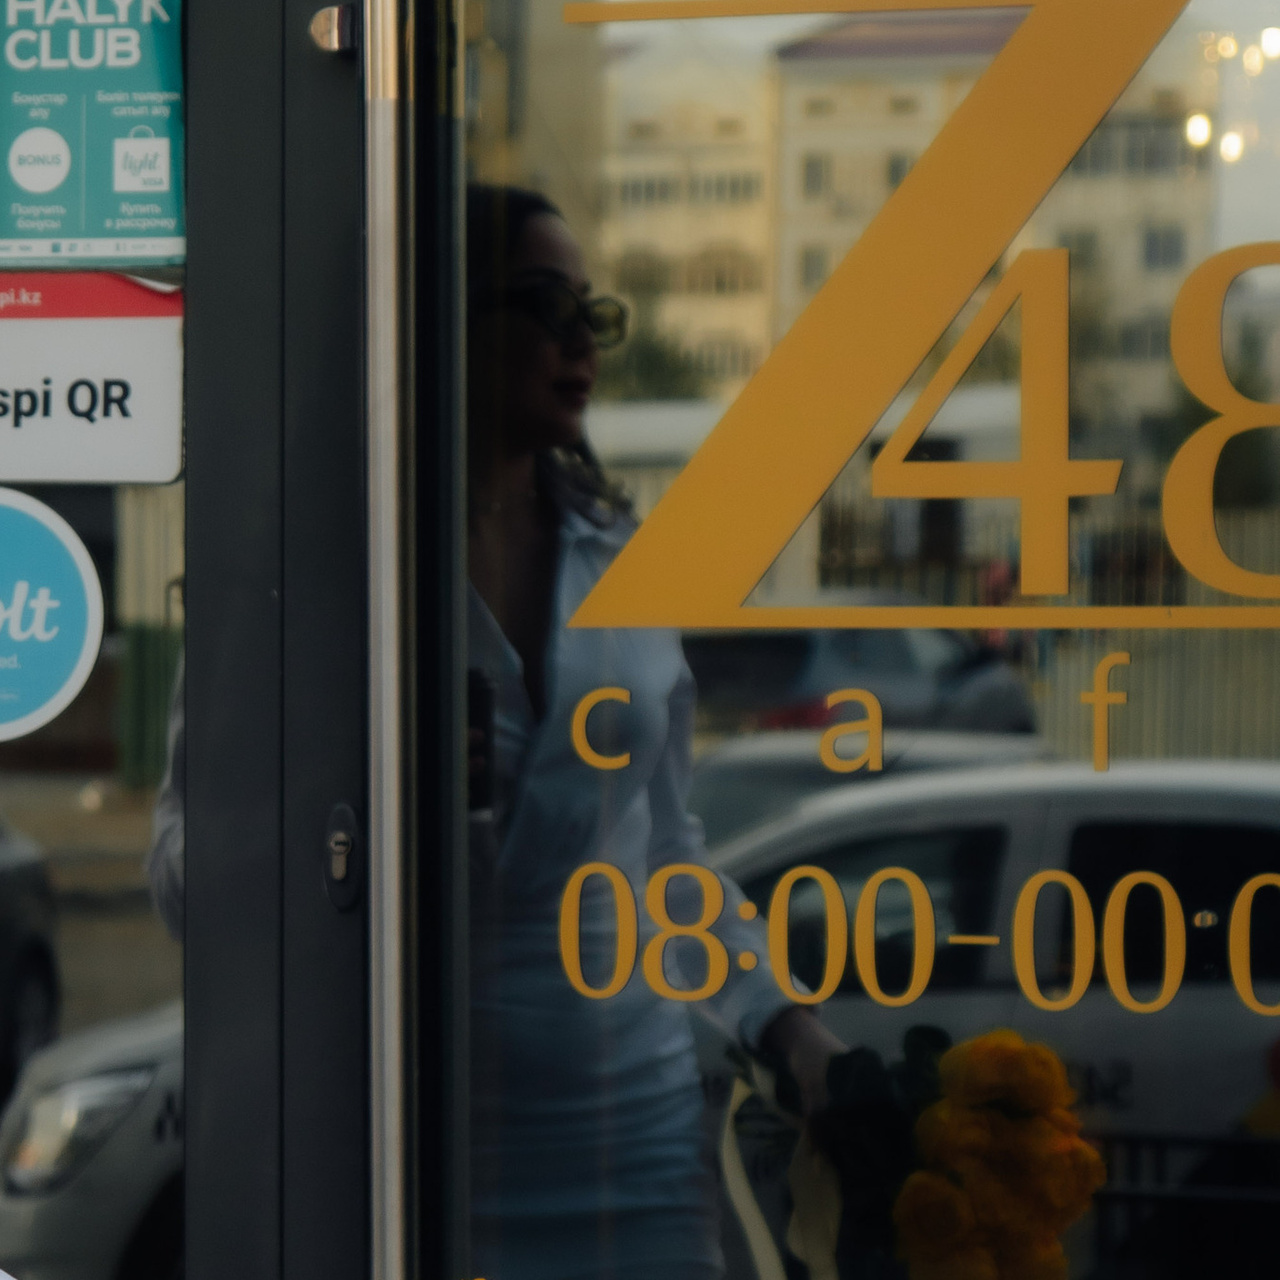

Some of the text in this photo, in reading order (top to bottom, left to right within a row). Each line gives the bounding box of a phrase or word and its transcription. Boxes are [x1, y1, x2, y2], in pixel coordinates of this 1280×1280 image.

[5, 27, 142, 69] CLUB
[18, 154, 61, 166] BONUS
[68, 378, 132, 423] QR
